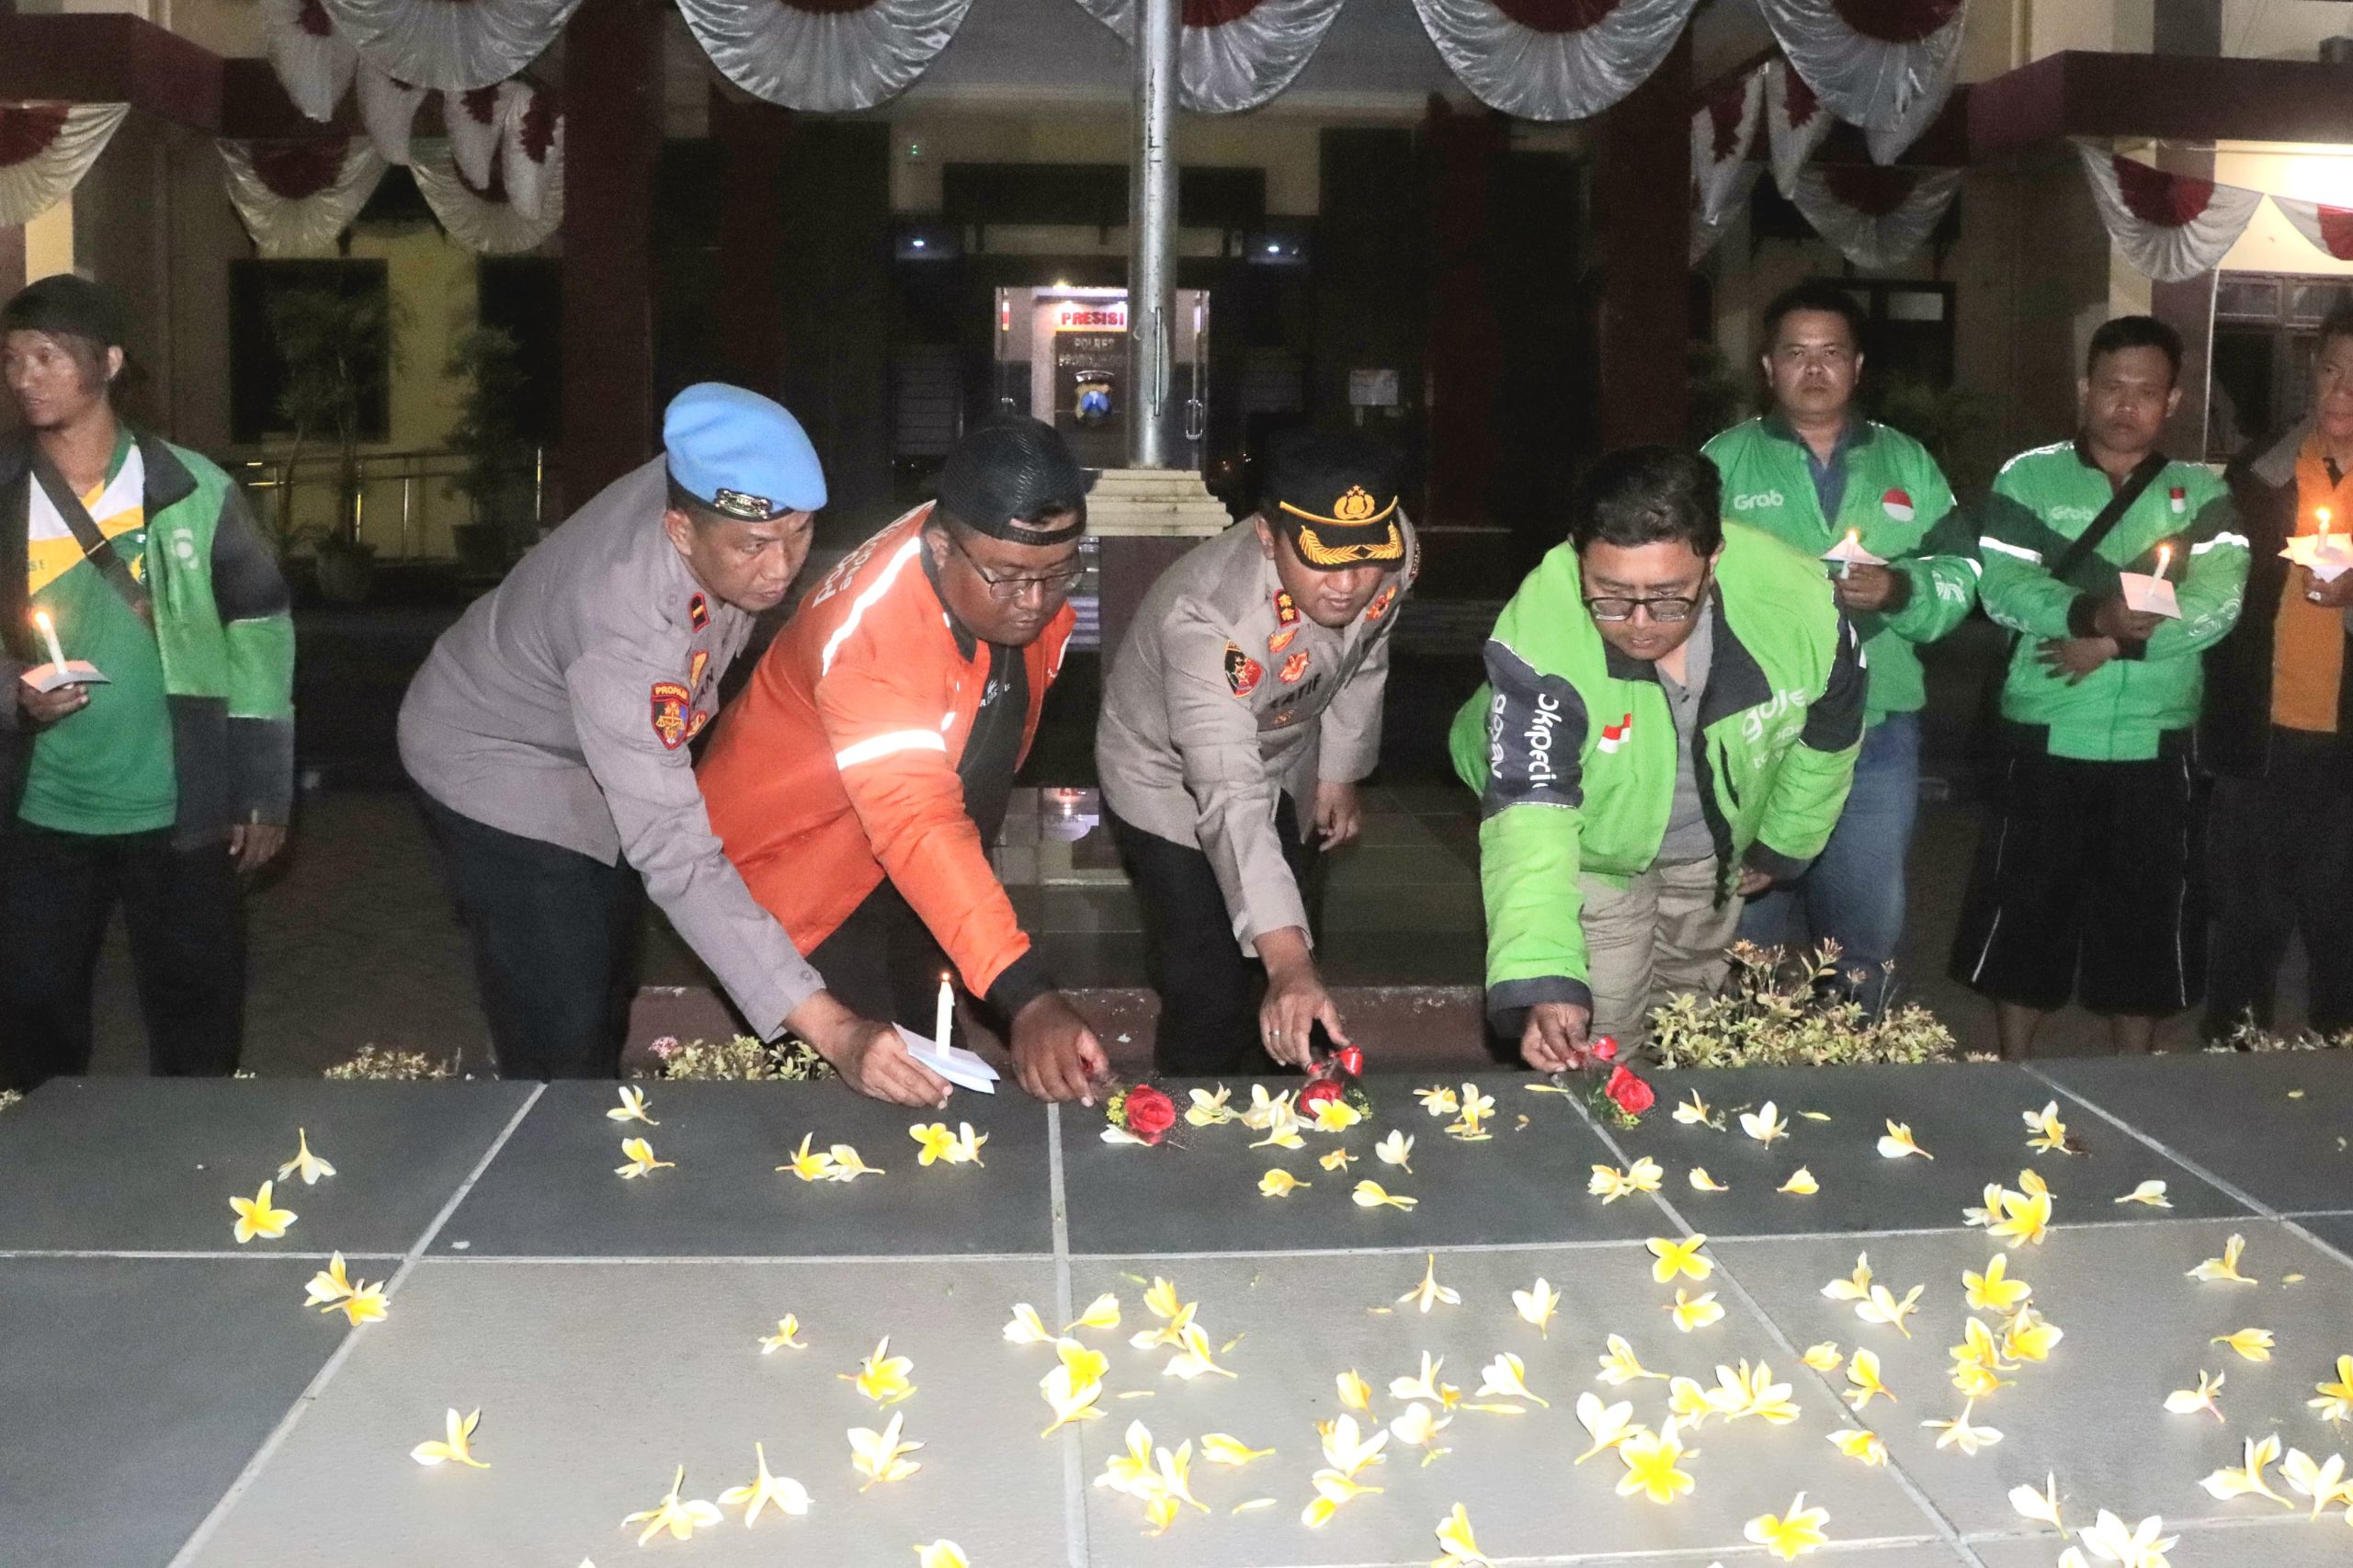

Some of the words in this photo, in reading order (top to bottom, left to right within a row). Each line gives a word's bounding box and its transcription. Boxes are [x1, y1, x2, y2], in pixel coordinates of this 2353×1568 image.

[1061, 312, 1124, 325] PRESISI
[1733, 489, 1784, 510] Grab
[2051, 506, 2094, 521] Grab
